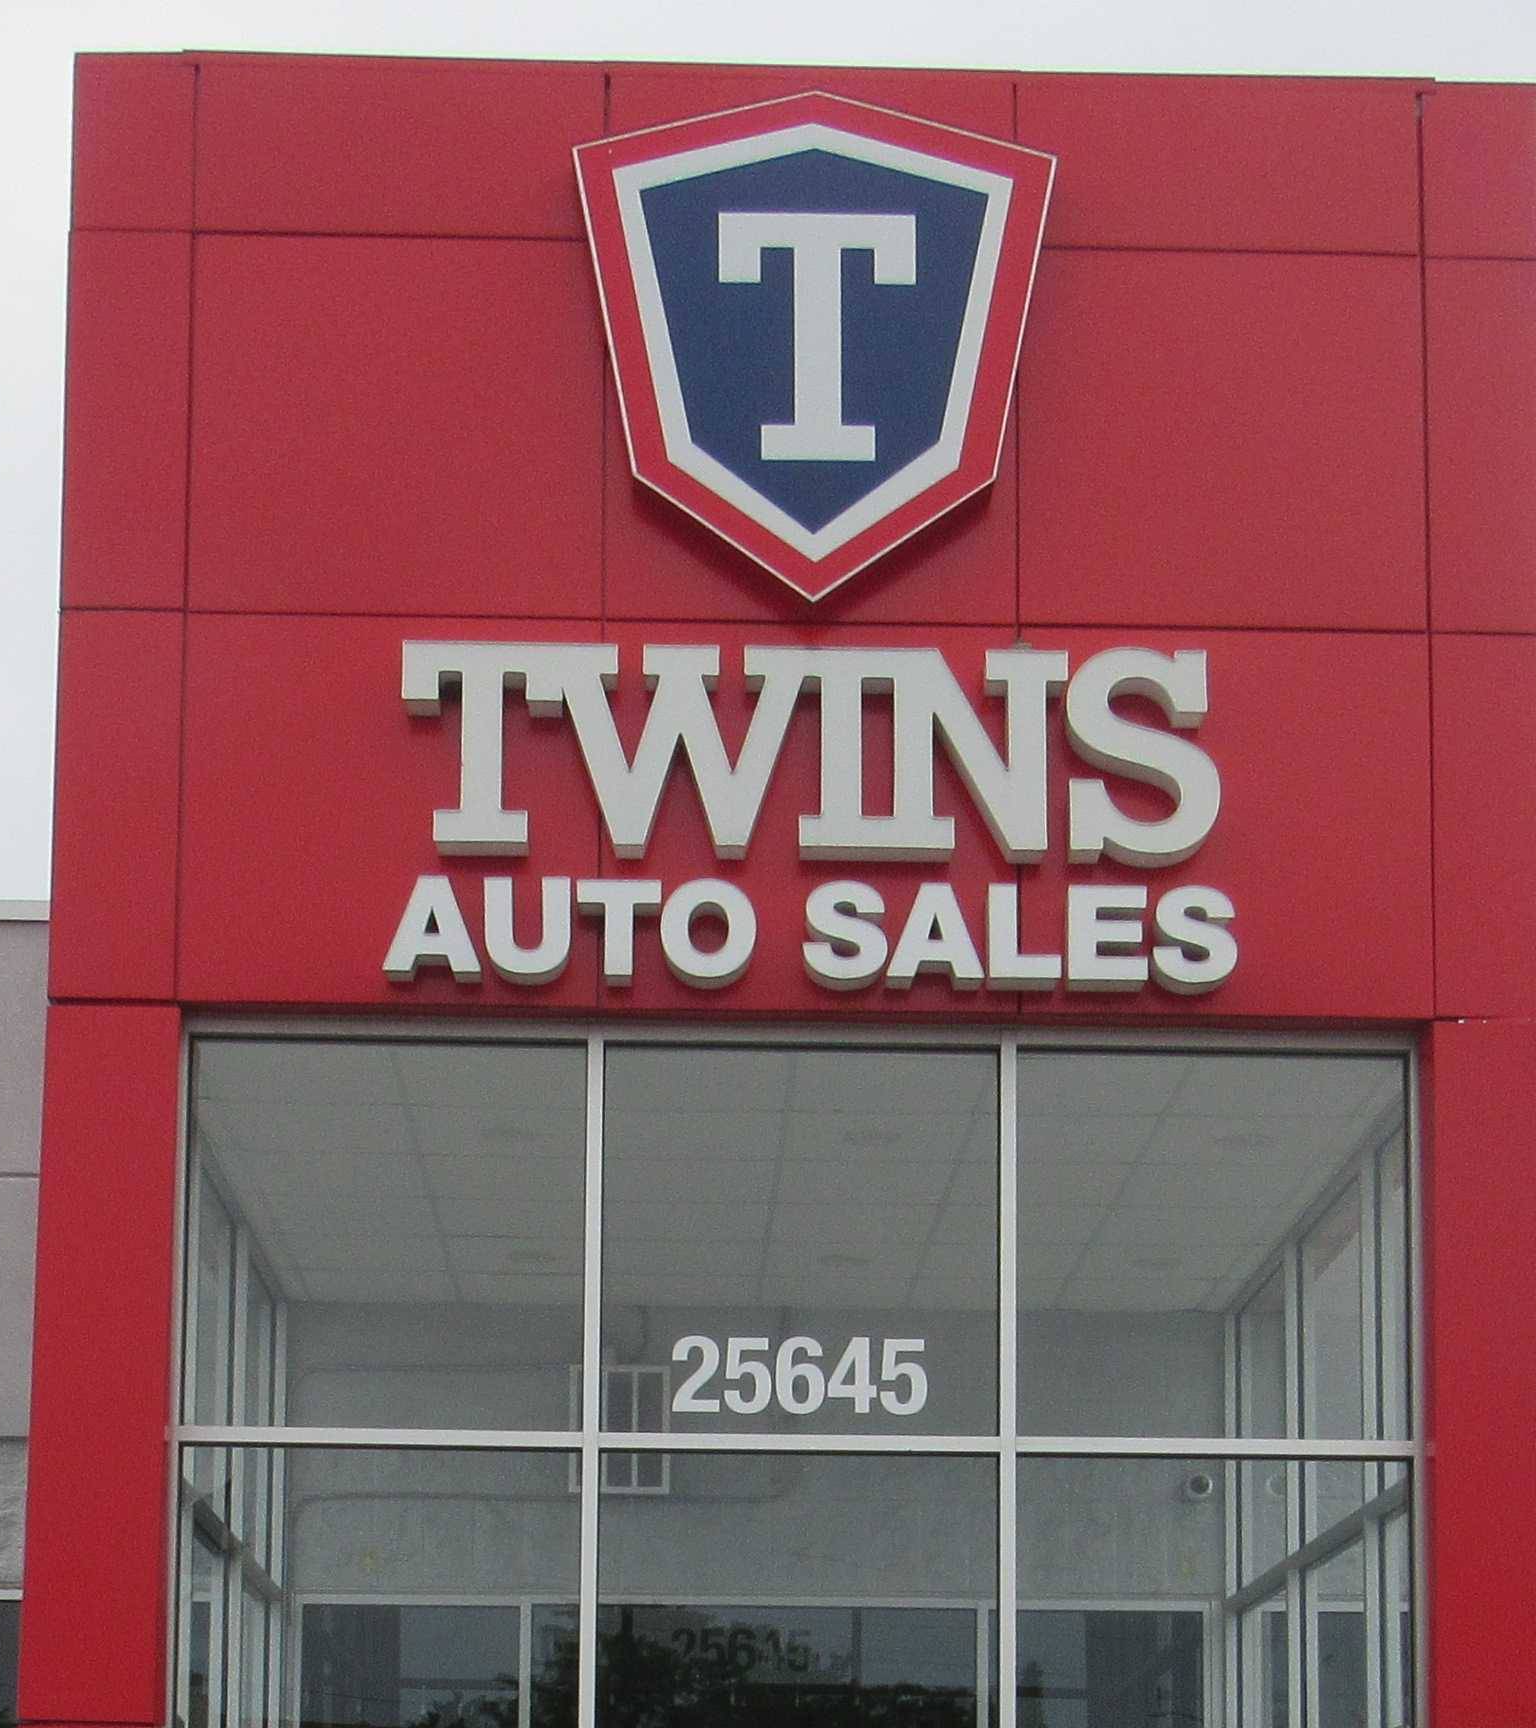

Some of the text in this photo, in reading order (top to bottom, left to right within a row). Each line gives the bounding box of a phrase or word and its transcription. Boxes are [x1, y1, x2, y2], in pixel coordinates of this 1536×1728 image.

[718, 212, 916, 461] T
[401, 639, 1221, 865] TWINS
[382, 874, 1239, 995] AUTO SALES
[671, 1334, 928, 1416] 25645
